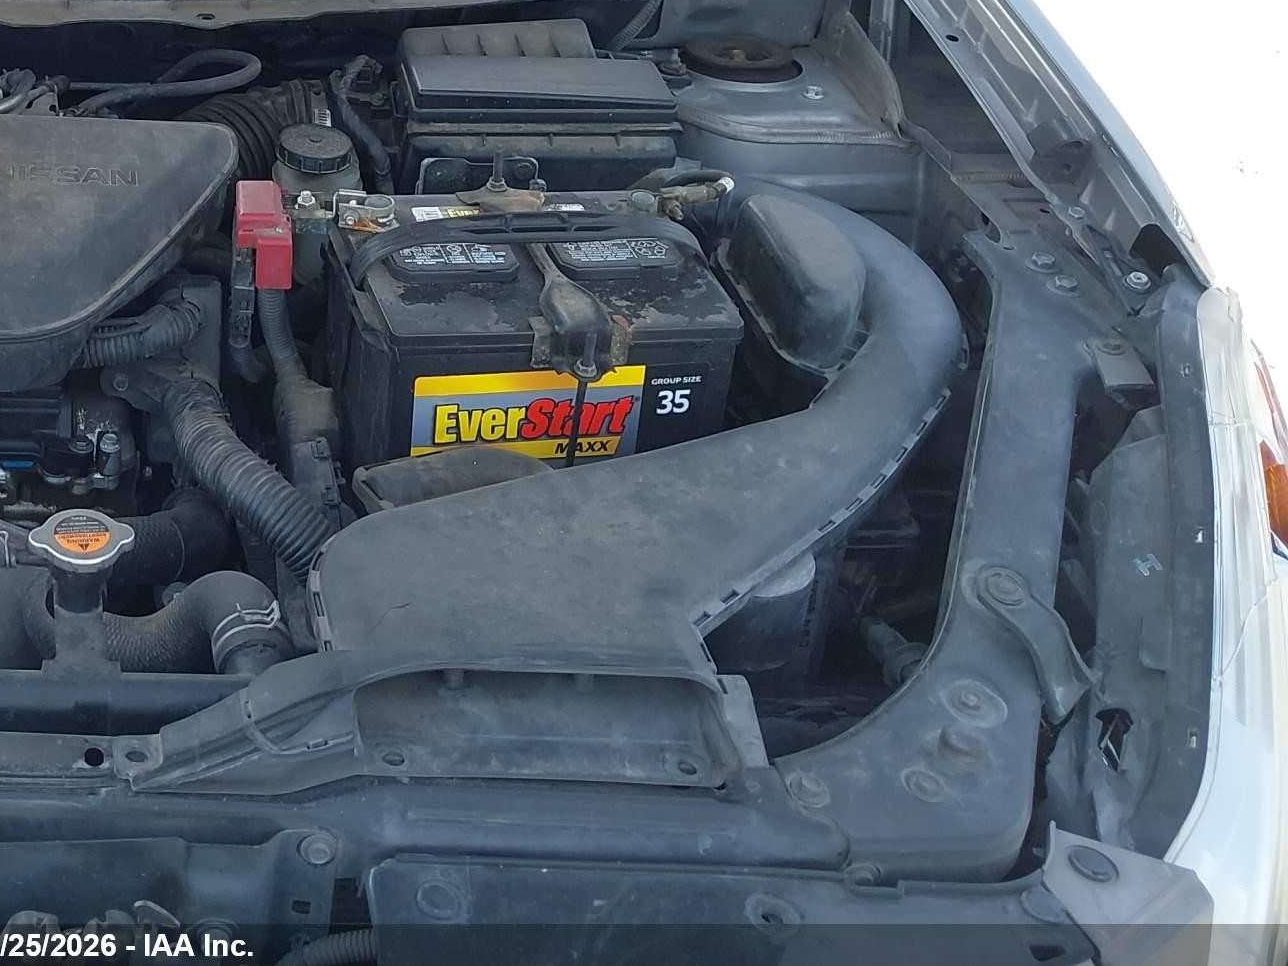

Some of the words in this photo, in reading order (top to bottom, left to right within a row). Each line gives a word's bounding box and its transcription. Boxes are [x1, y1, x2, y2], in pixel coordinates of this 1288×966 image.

[651, 377, 682, 386] GROUP
[682, 375, 703, 384] SIZE
[656, 389, 691, 414] 35
[434, 395, 634, 445] EverStart
[555, 440, 611, 454] MAXX
